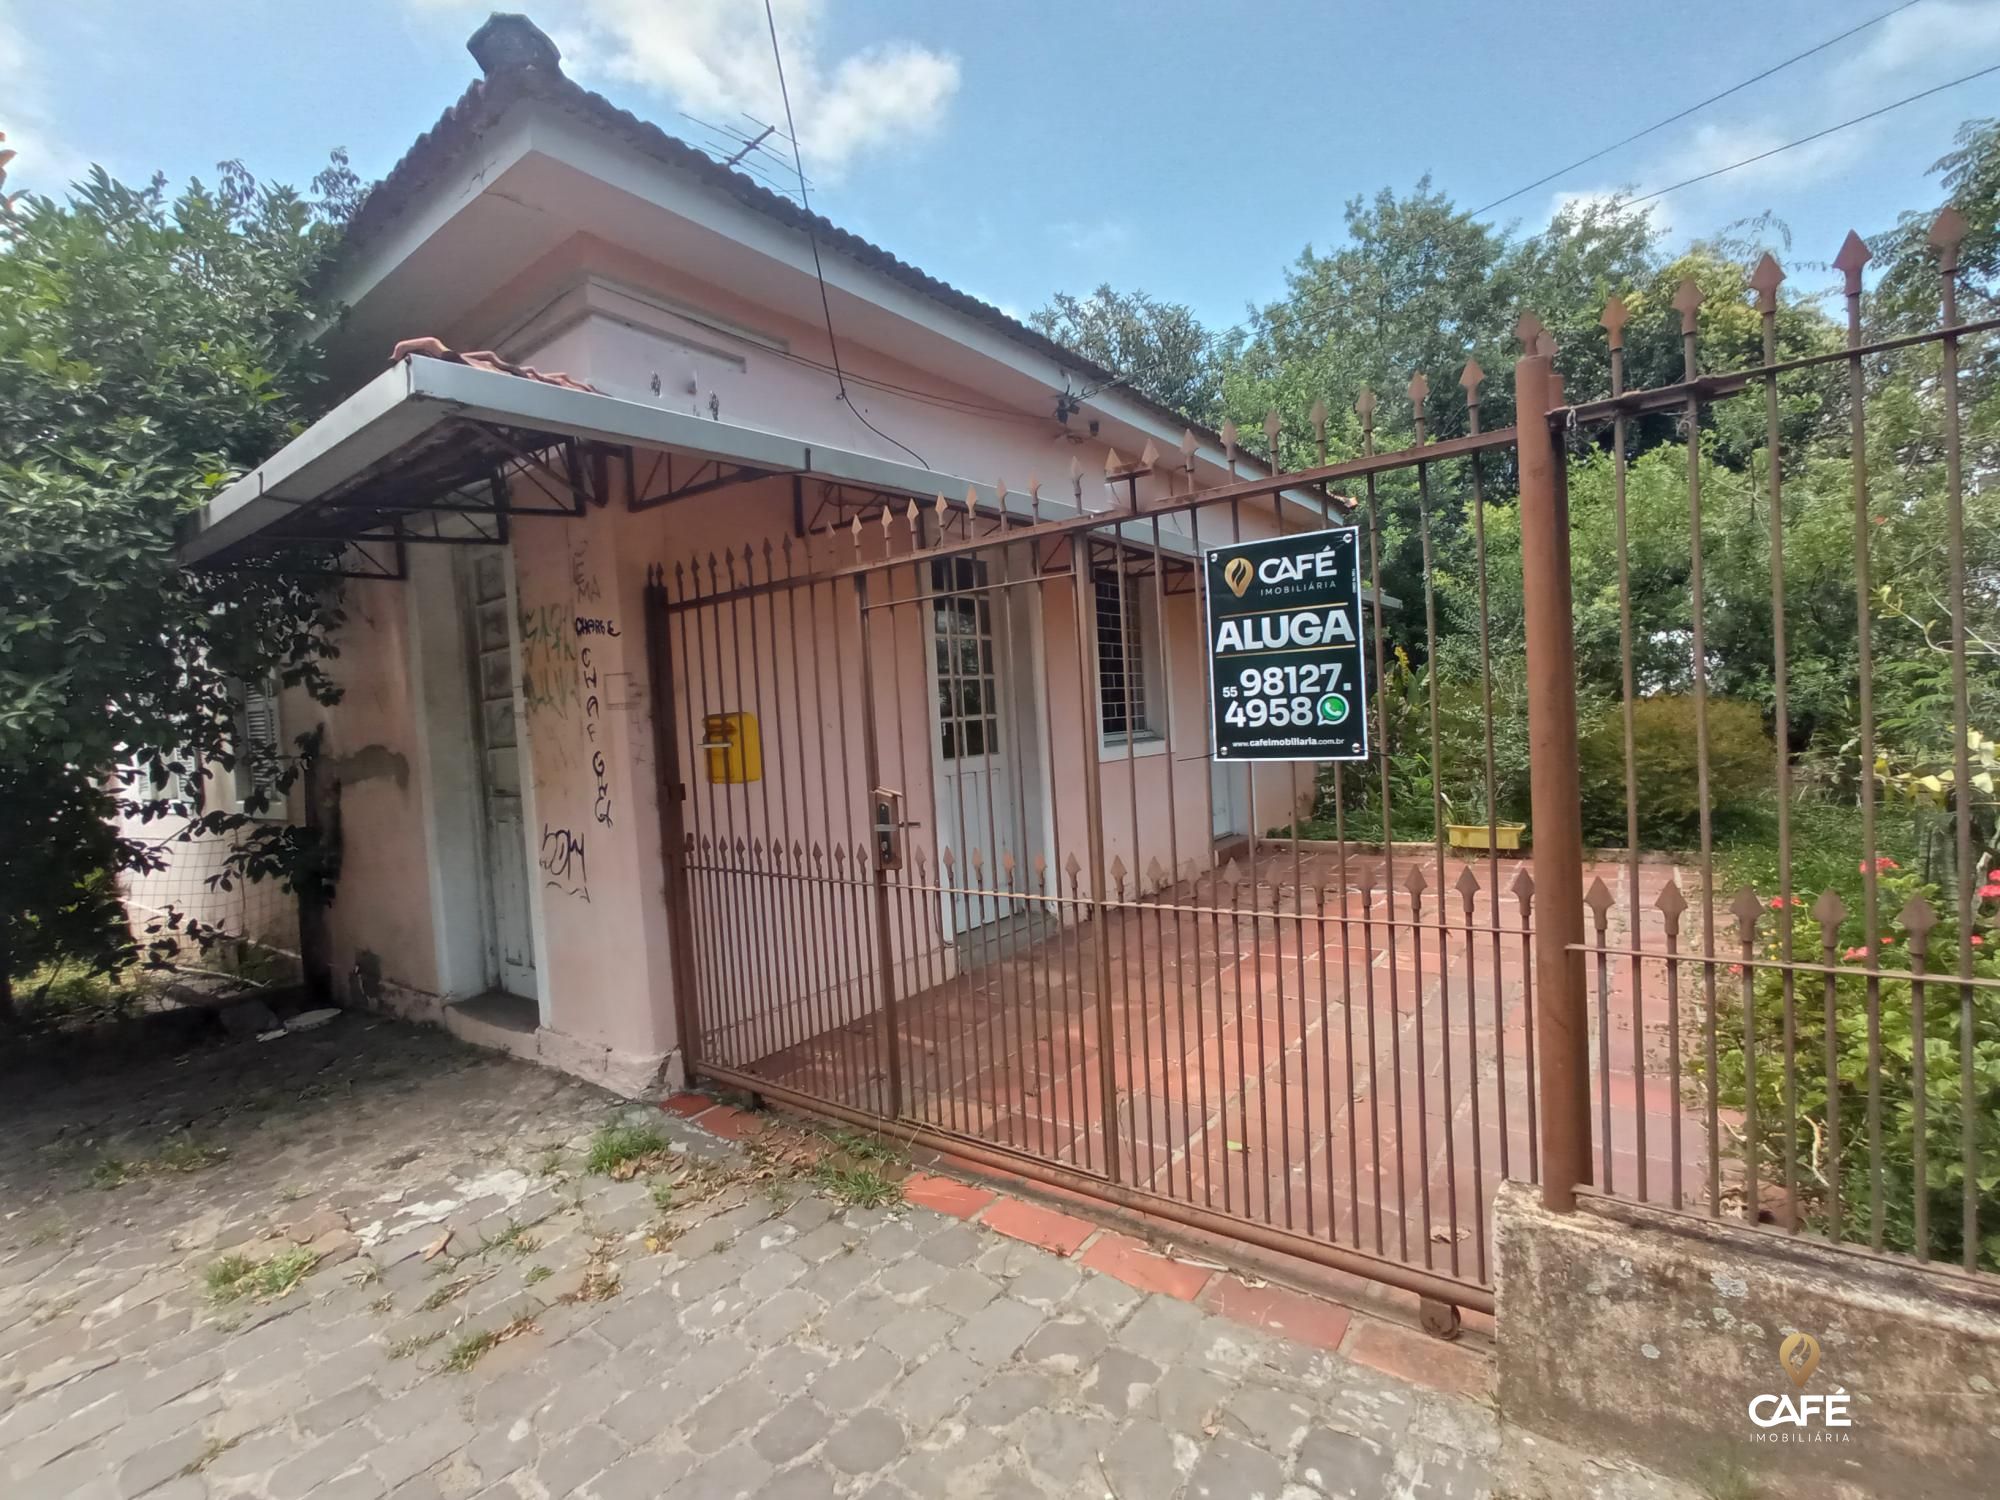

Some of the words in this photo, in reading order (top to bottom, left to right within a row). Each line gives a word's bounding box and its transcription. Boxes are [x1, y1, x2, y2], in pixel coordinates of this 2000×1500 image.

[1258, 545, 1337, 584] CAFÉ
[1260, 580, 1337, 596] IMOBILIÁRIA
[1215, 609, 1356, 653] ALUGA
[1222, 686, 1238, 698] 55
[1224, 696, 1313, 728] 4958
[1232, 737, 1345, 748] www.cafeimobiliaria.com.br
